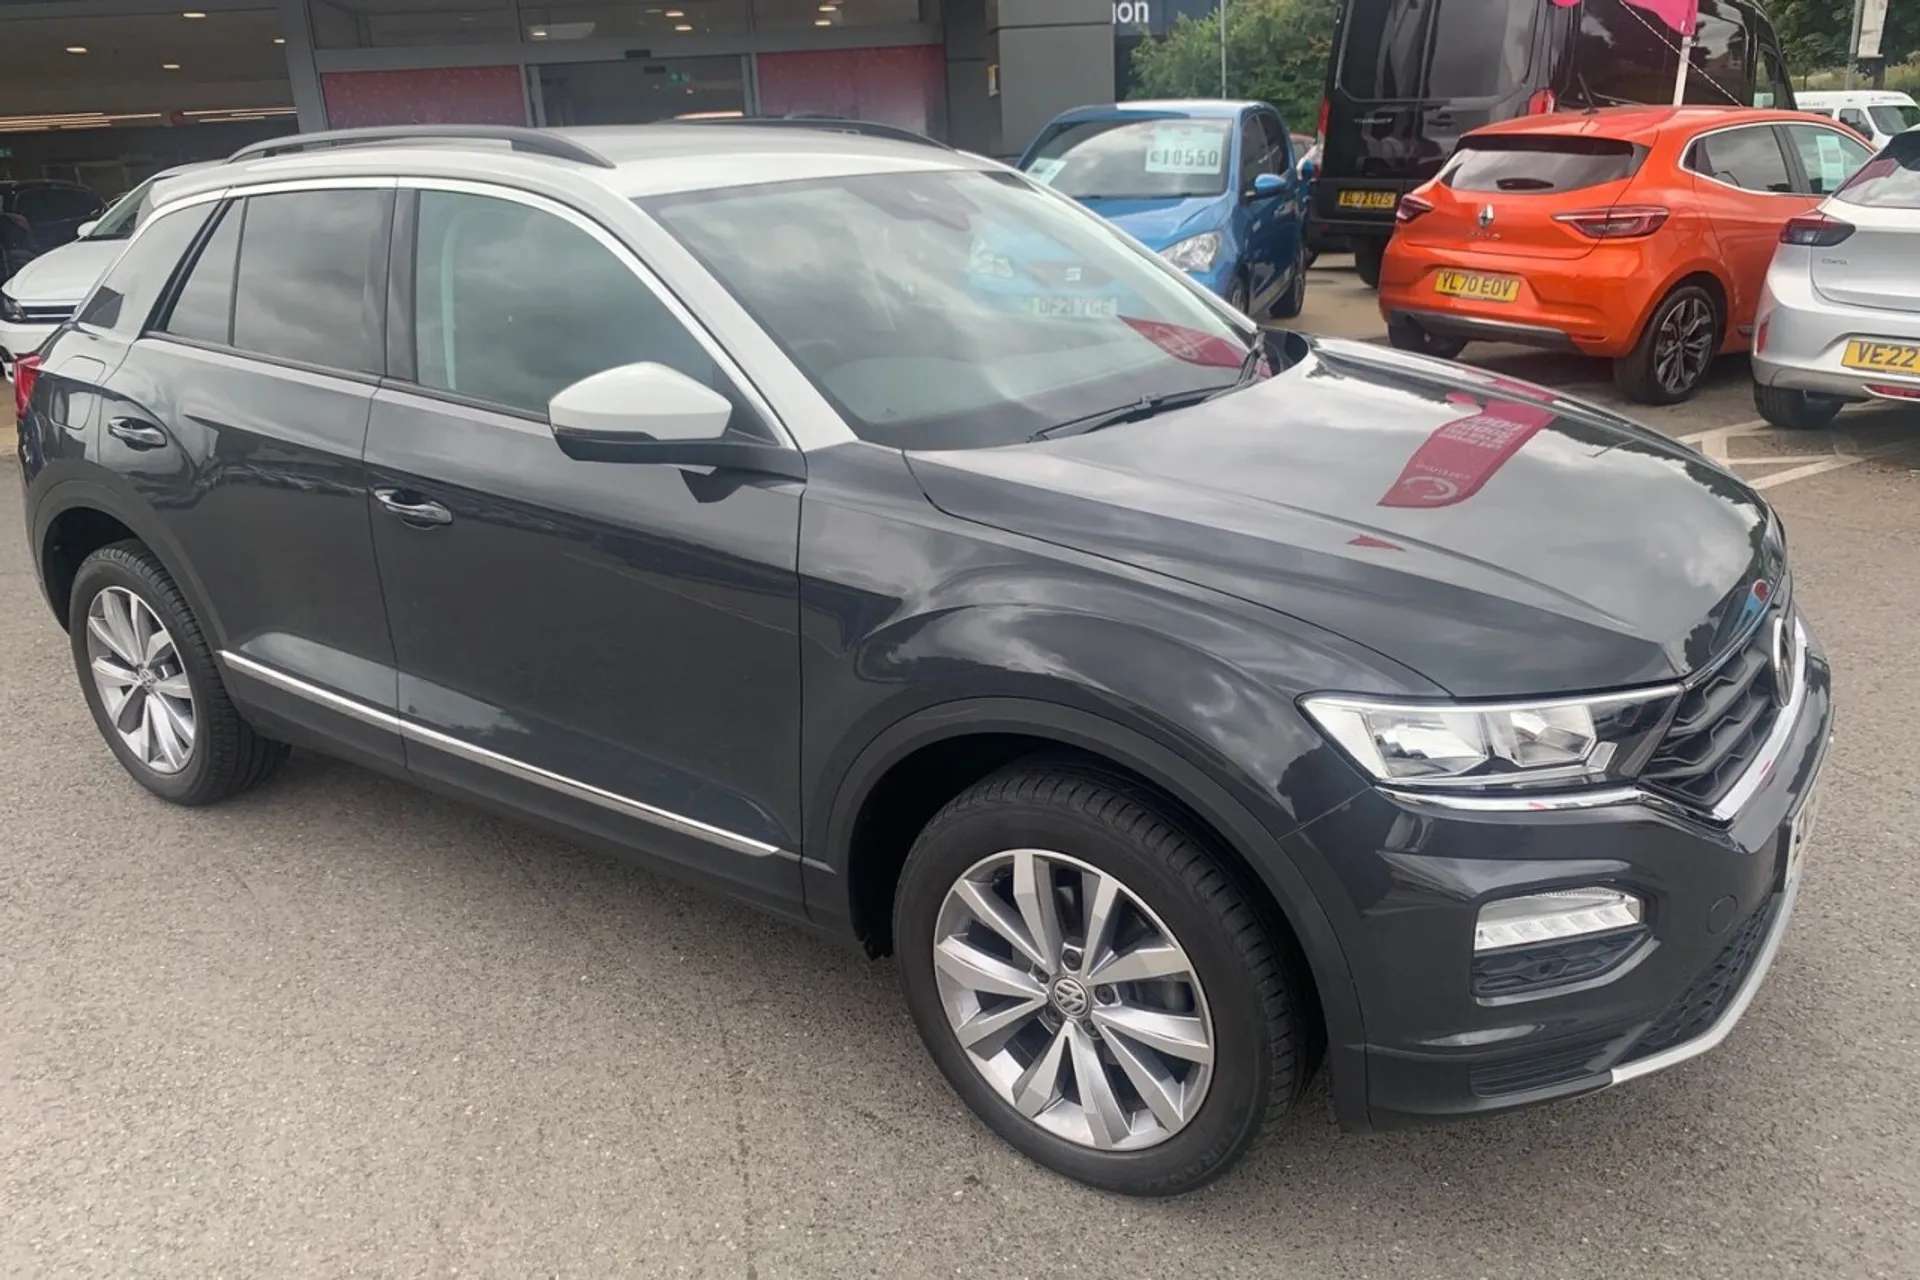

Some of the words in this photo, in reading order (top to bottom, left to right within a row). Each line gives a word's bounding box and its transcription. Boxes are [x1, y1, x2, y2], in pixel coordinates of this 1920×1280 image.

[1441, 271, 1479, 292] YL70
[1480, 277, 1513, 296] EOV
[1858, 341, 1919, 367] VE22
